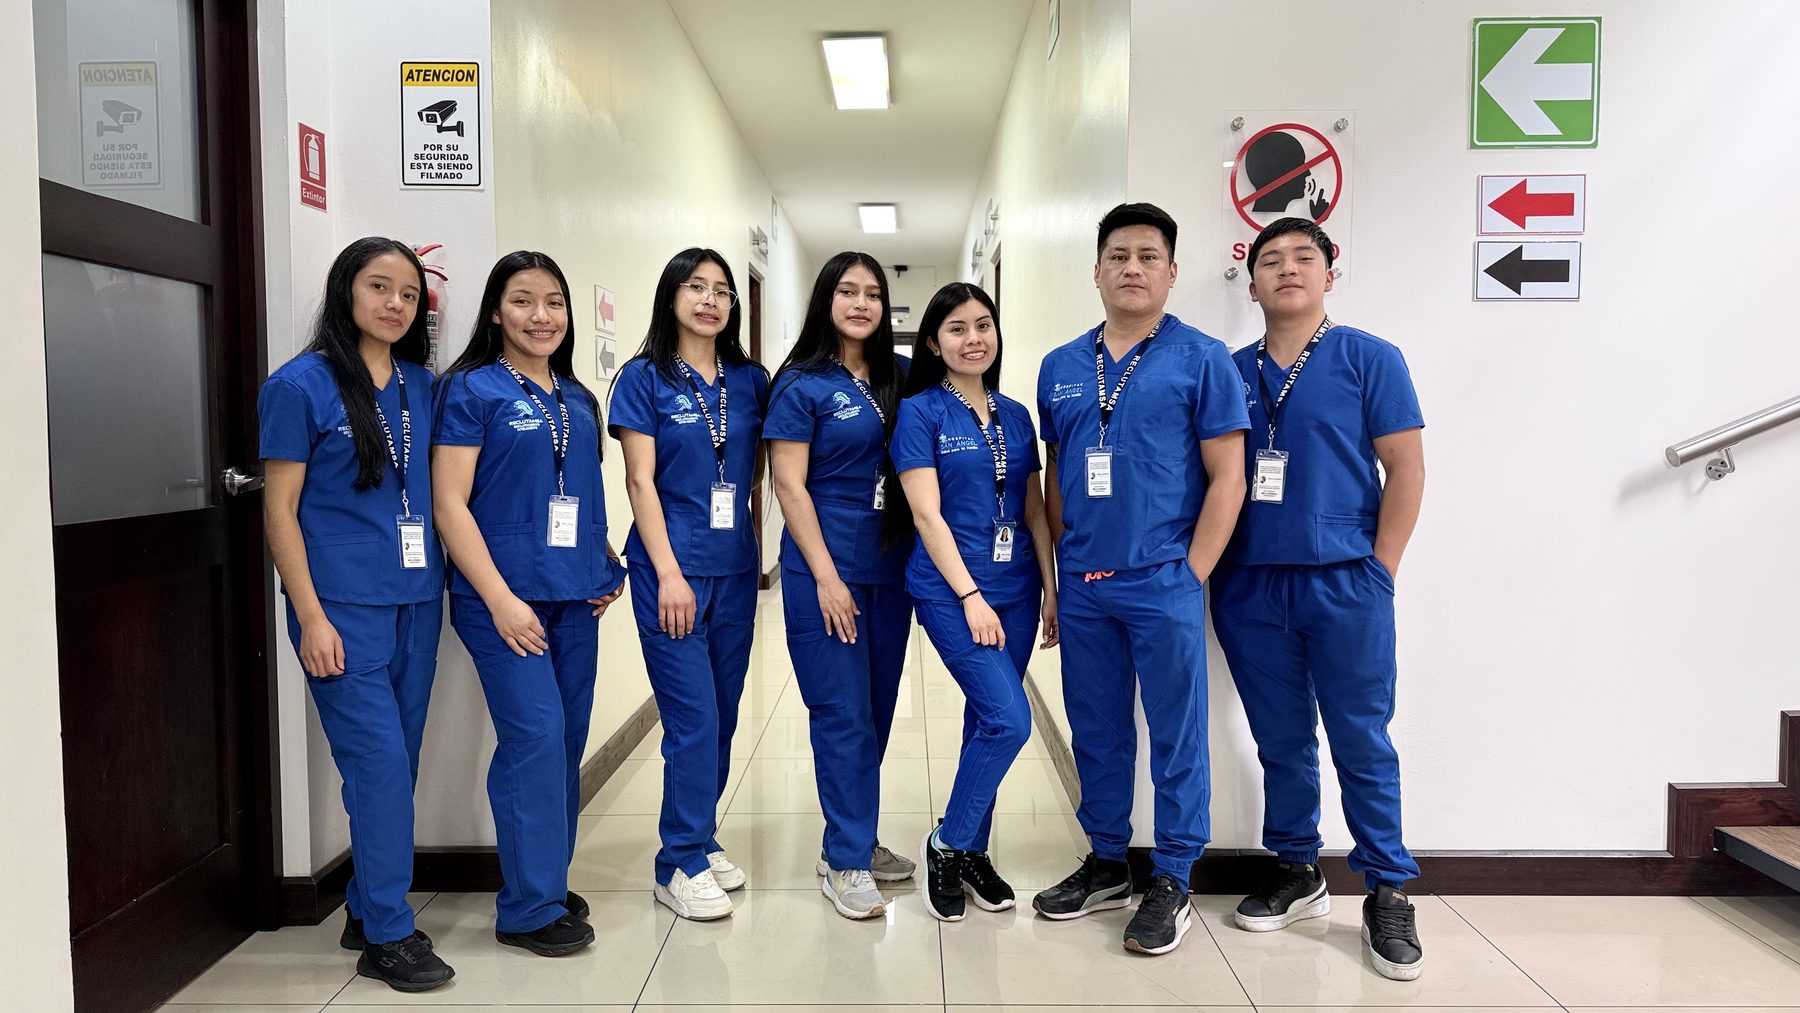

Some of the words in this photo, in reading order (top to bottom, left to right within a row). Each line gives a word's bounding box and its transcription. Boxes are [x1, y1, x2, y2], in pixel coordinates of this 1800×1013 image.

[405, 69, 475, 82] ATENCION
[410, 162, 434, 170] ESTA
[437, 162, 473, 170] SIENDO
[413, 153, 469, 161] SEGURIDAD
[420, 172, 463, 180] FILMADO
[302, 187, 325, 204] Extintor
[1096, 353, 1107, 408] RECLUTAMSA
[1105, 355, 1140, 411] RECLUTAMSA
[530, 394, 560, 452] RECLUTAMSA
[559, 402, 570, 458] RECLUTAMSA
[695, 392, 720, 449] RECLUTAMSA
[719, 387, 727, 443] RECLUTAMSA
[979, 425, 1003, 481] RECLUTAMSA
